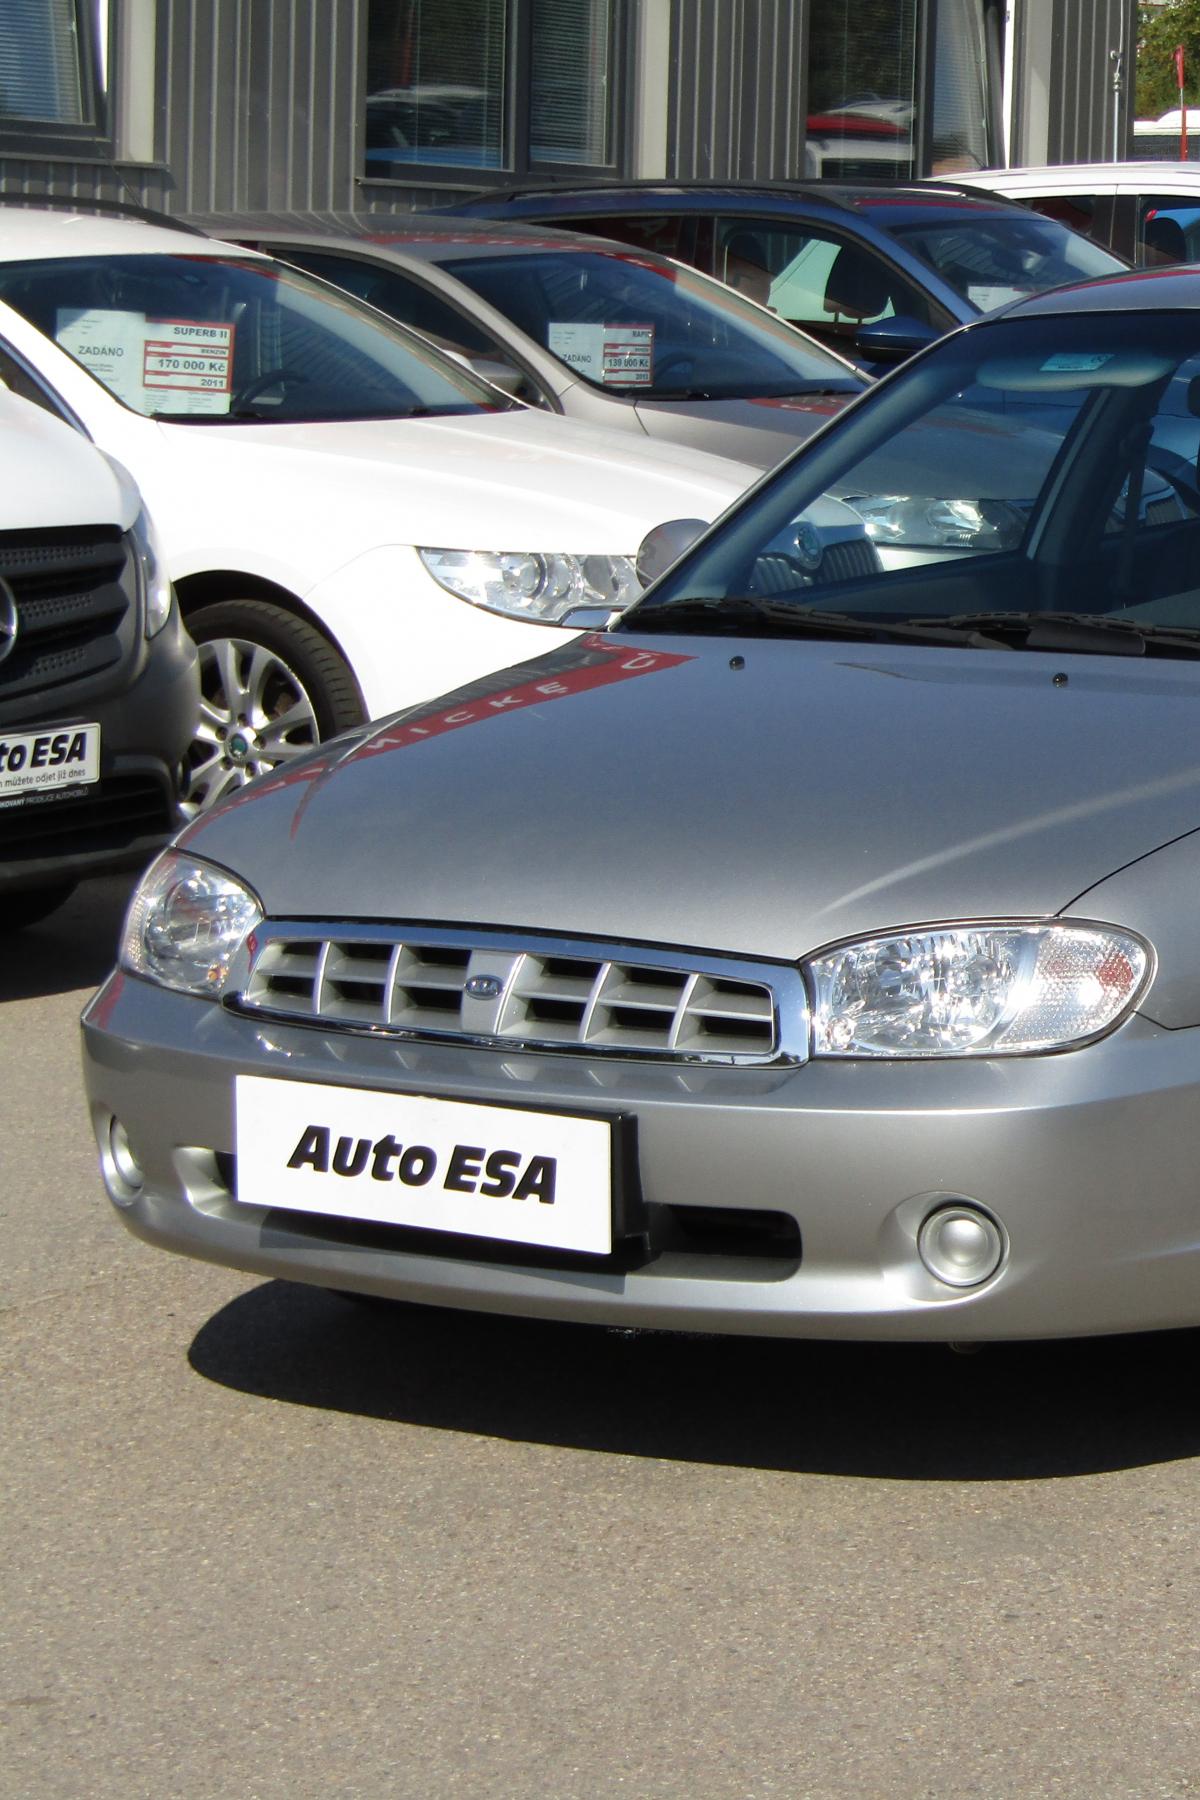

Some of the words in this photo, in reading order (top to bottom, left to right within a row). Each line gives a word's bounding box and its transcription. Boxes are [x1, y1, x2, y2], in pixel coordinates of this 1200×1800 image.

[173, 326, 216, 338] SUPERB
[78, 344, 124, 357] ZADÁNO
[158, 358, 180, 369] 170
[183, 360, 206, 371] 000
[209, 360, 226, 372] Kč
[201, 378, 224, 388] 2011
[30, 732, 87, 768] ESA
[286, 1124, 438, 1188] Auto
[443, 1144, 558, 1205] ESA
